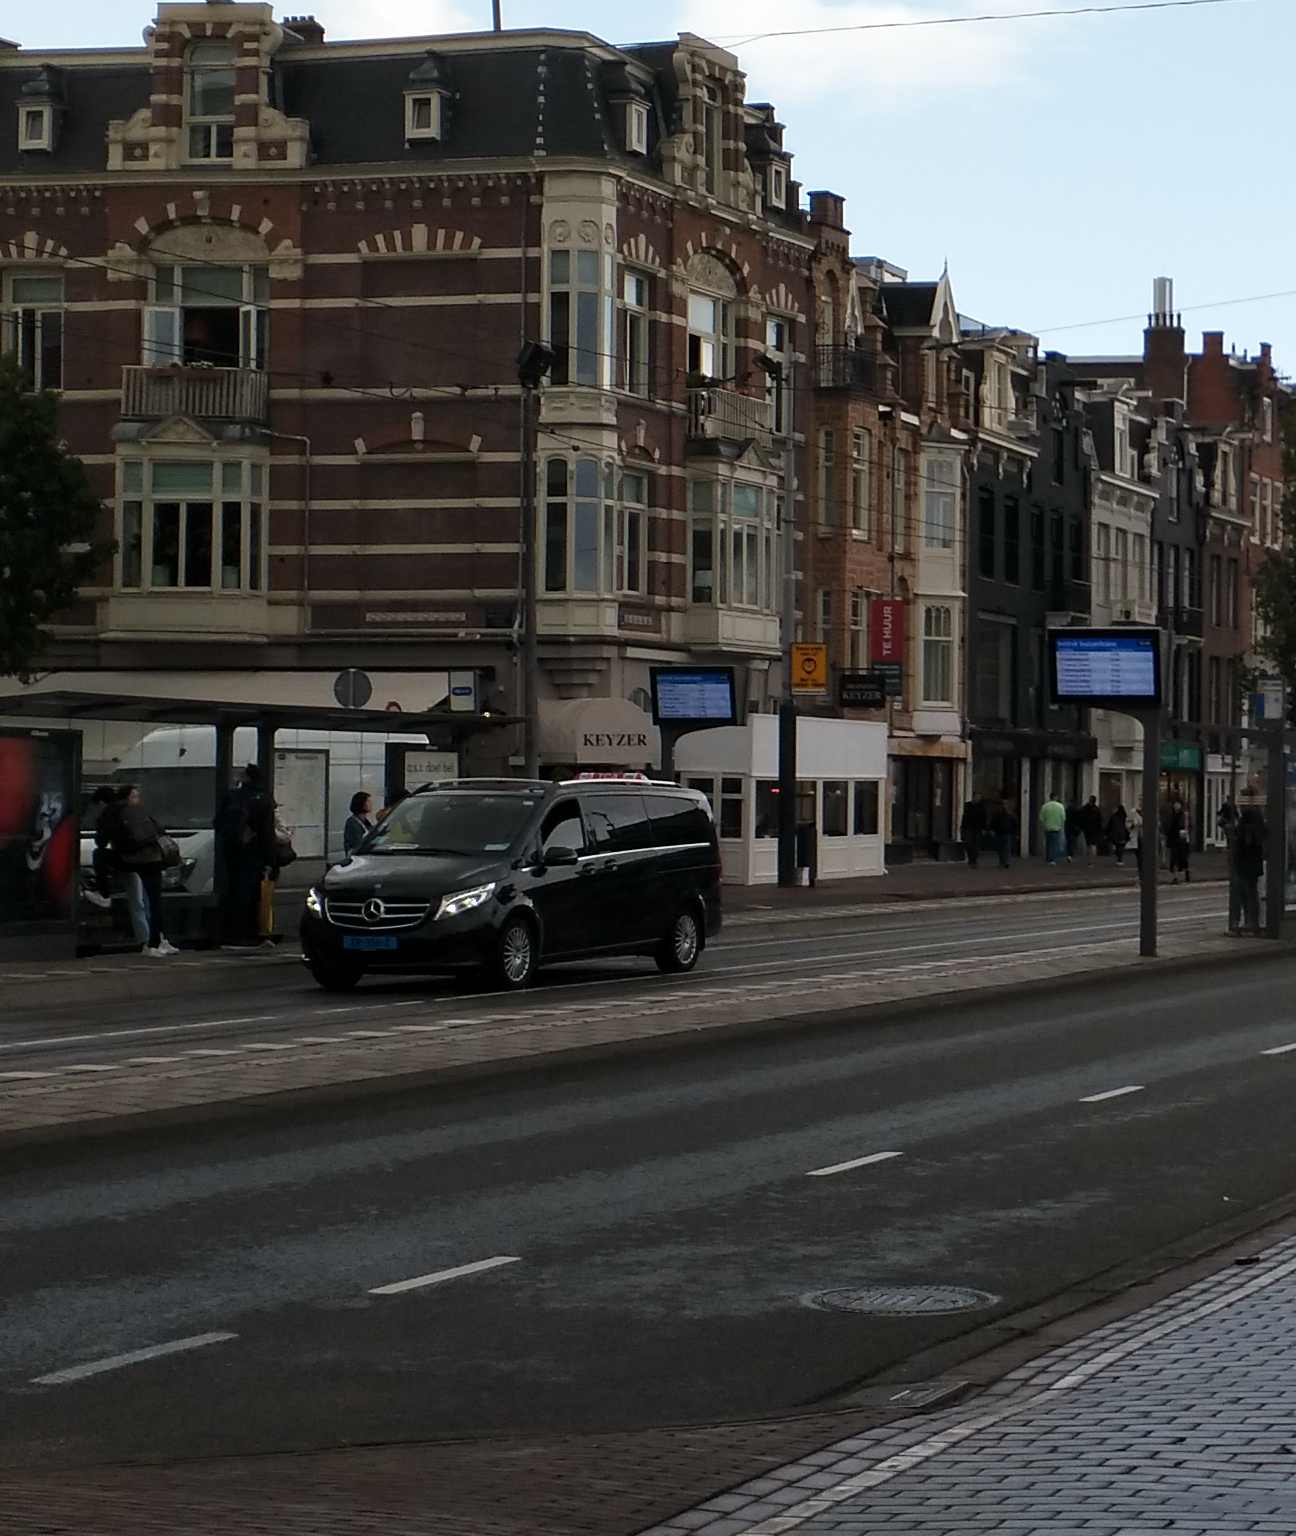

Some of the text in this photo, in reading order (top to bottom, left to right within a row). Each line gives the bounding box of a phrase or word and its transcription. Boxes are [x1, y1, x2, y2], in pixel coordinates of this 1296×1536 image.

[882, 606, 893, 657] TE HUUR
[842, 691, 881, 700] KEYZER
[583, 733, 648, 747] KEYZER
